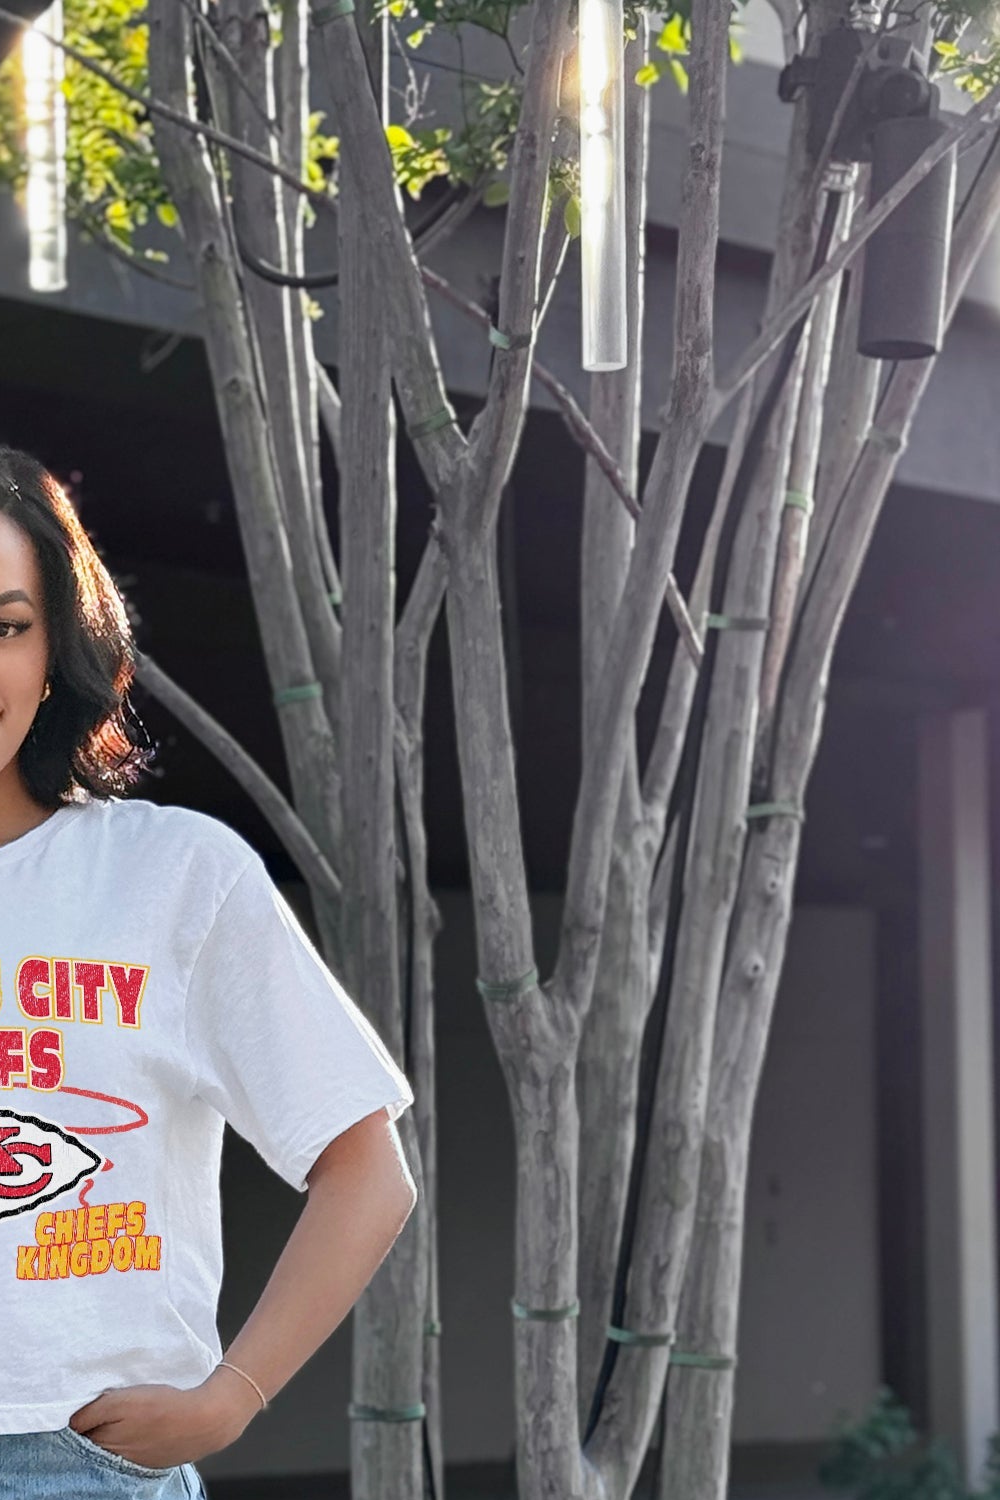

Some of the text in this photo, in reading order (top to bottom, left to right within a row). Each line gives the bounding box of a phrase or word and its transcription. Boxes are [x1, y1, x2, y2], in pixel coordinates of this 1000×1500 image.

[15, 955, 150, 1029] CITY
[35, 1202, 148, 1246] CHIEFS
[16, 1235, 161, 1280] KINGDOM
